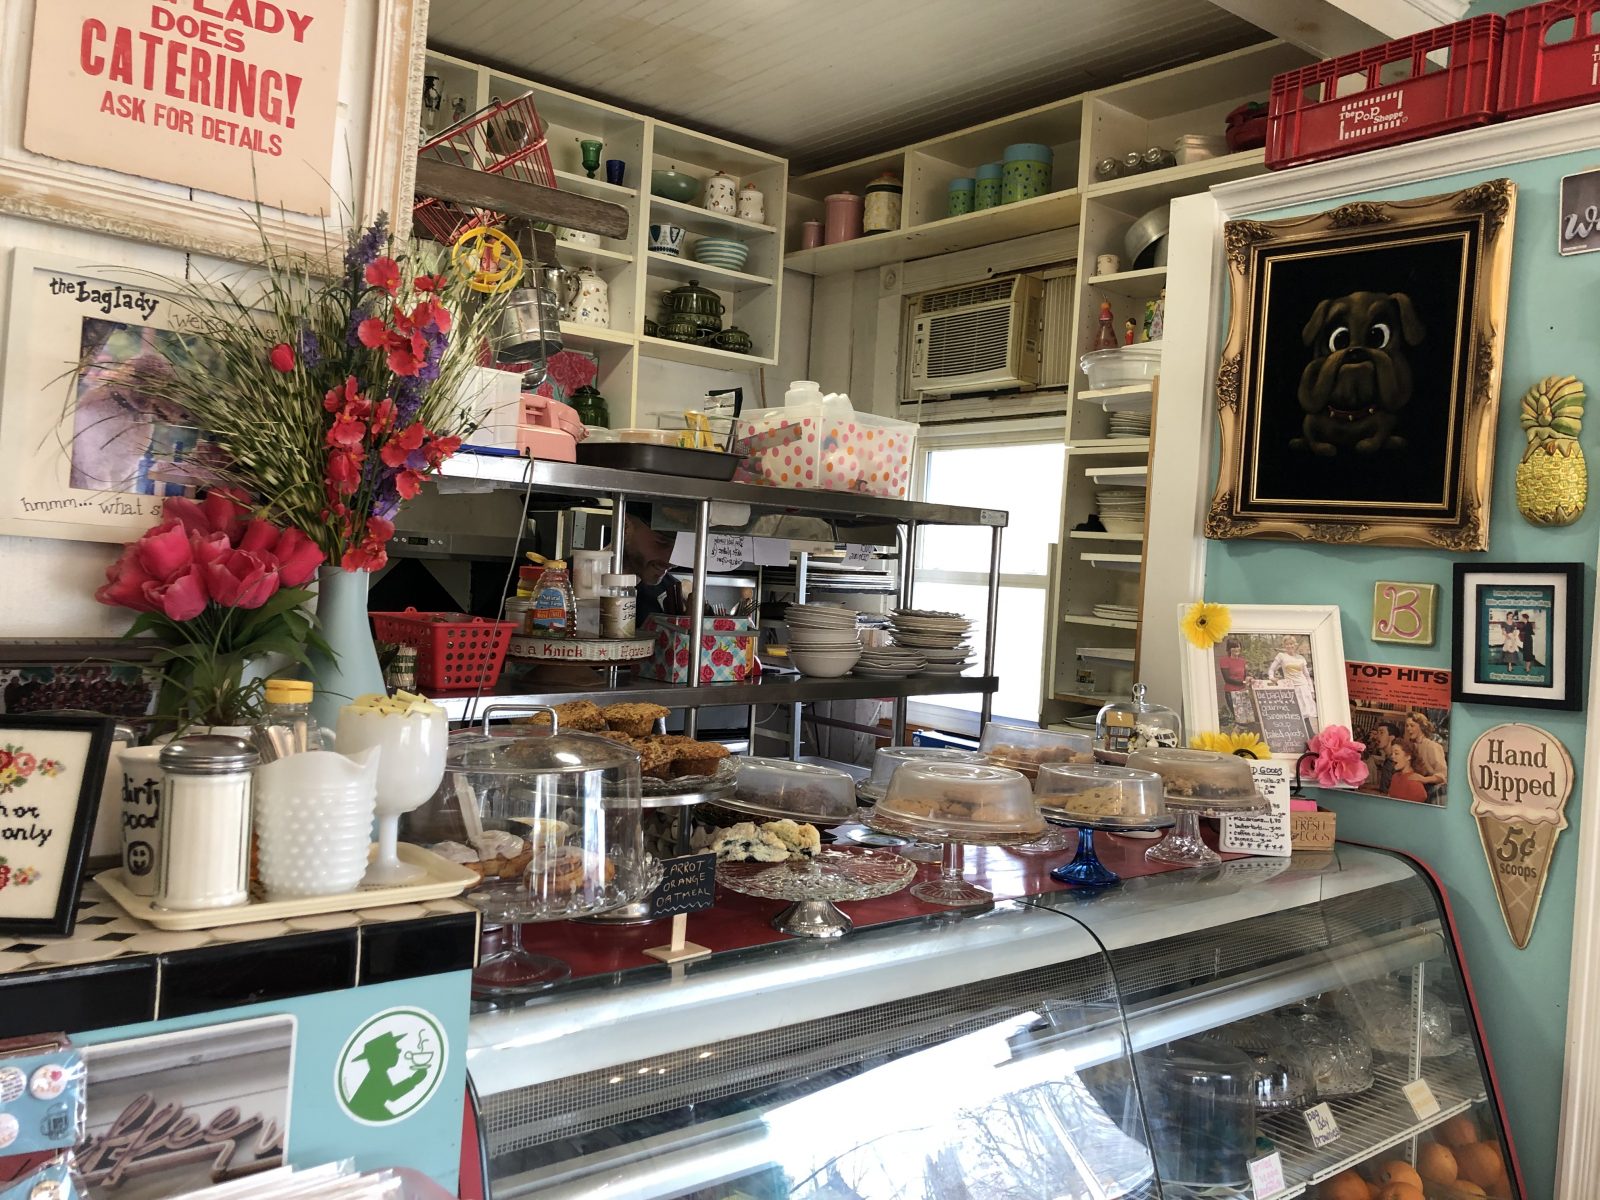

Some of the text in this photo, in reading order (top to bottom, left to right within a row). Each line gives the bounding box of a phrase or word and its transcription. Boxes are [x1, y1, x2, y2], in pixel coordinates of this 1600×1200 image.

[151, 5, 245, 53] DOES
[193, 0, 314, 43] LADY
[80, 18, 302, 129] CATERING!
[100, 91, 283, 157] ASK FOR DETAILS
[49, 277, 76, 295] the
[100, 496, 143, 516] what
[1377, 586, 1423, 638] B
[543, 643, 583, 658] Knick
[1349, 664, 1392, 678] TOP
[1397, 668, 1449, 685] HITS
[1487, 739, 1548, 768] Hand
[1479, 765, 1557, 803] Dipped
[12, 806, 40, 819] or
[2, 823, 53, 848] only
[1496, 826, 1536, 862] 5¢
[663, 872, 706, 892] ORANGE
[1500, 862, 1537, 882] scoops
[656, 888, 711, 908] OATMEAL
[76, 1092, 264, 1189] ffee
